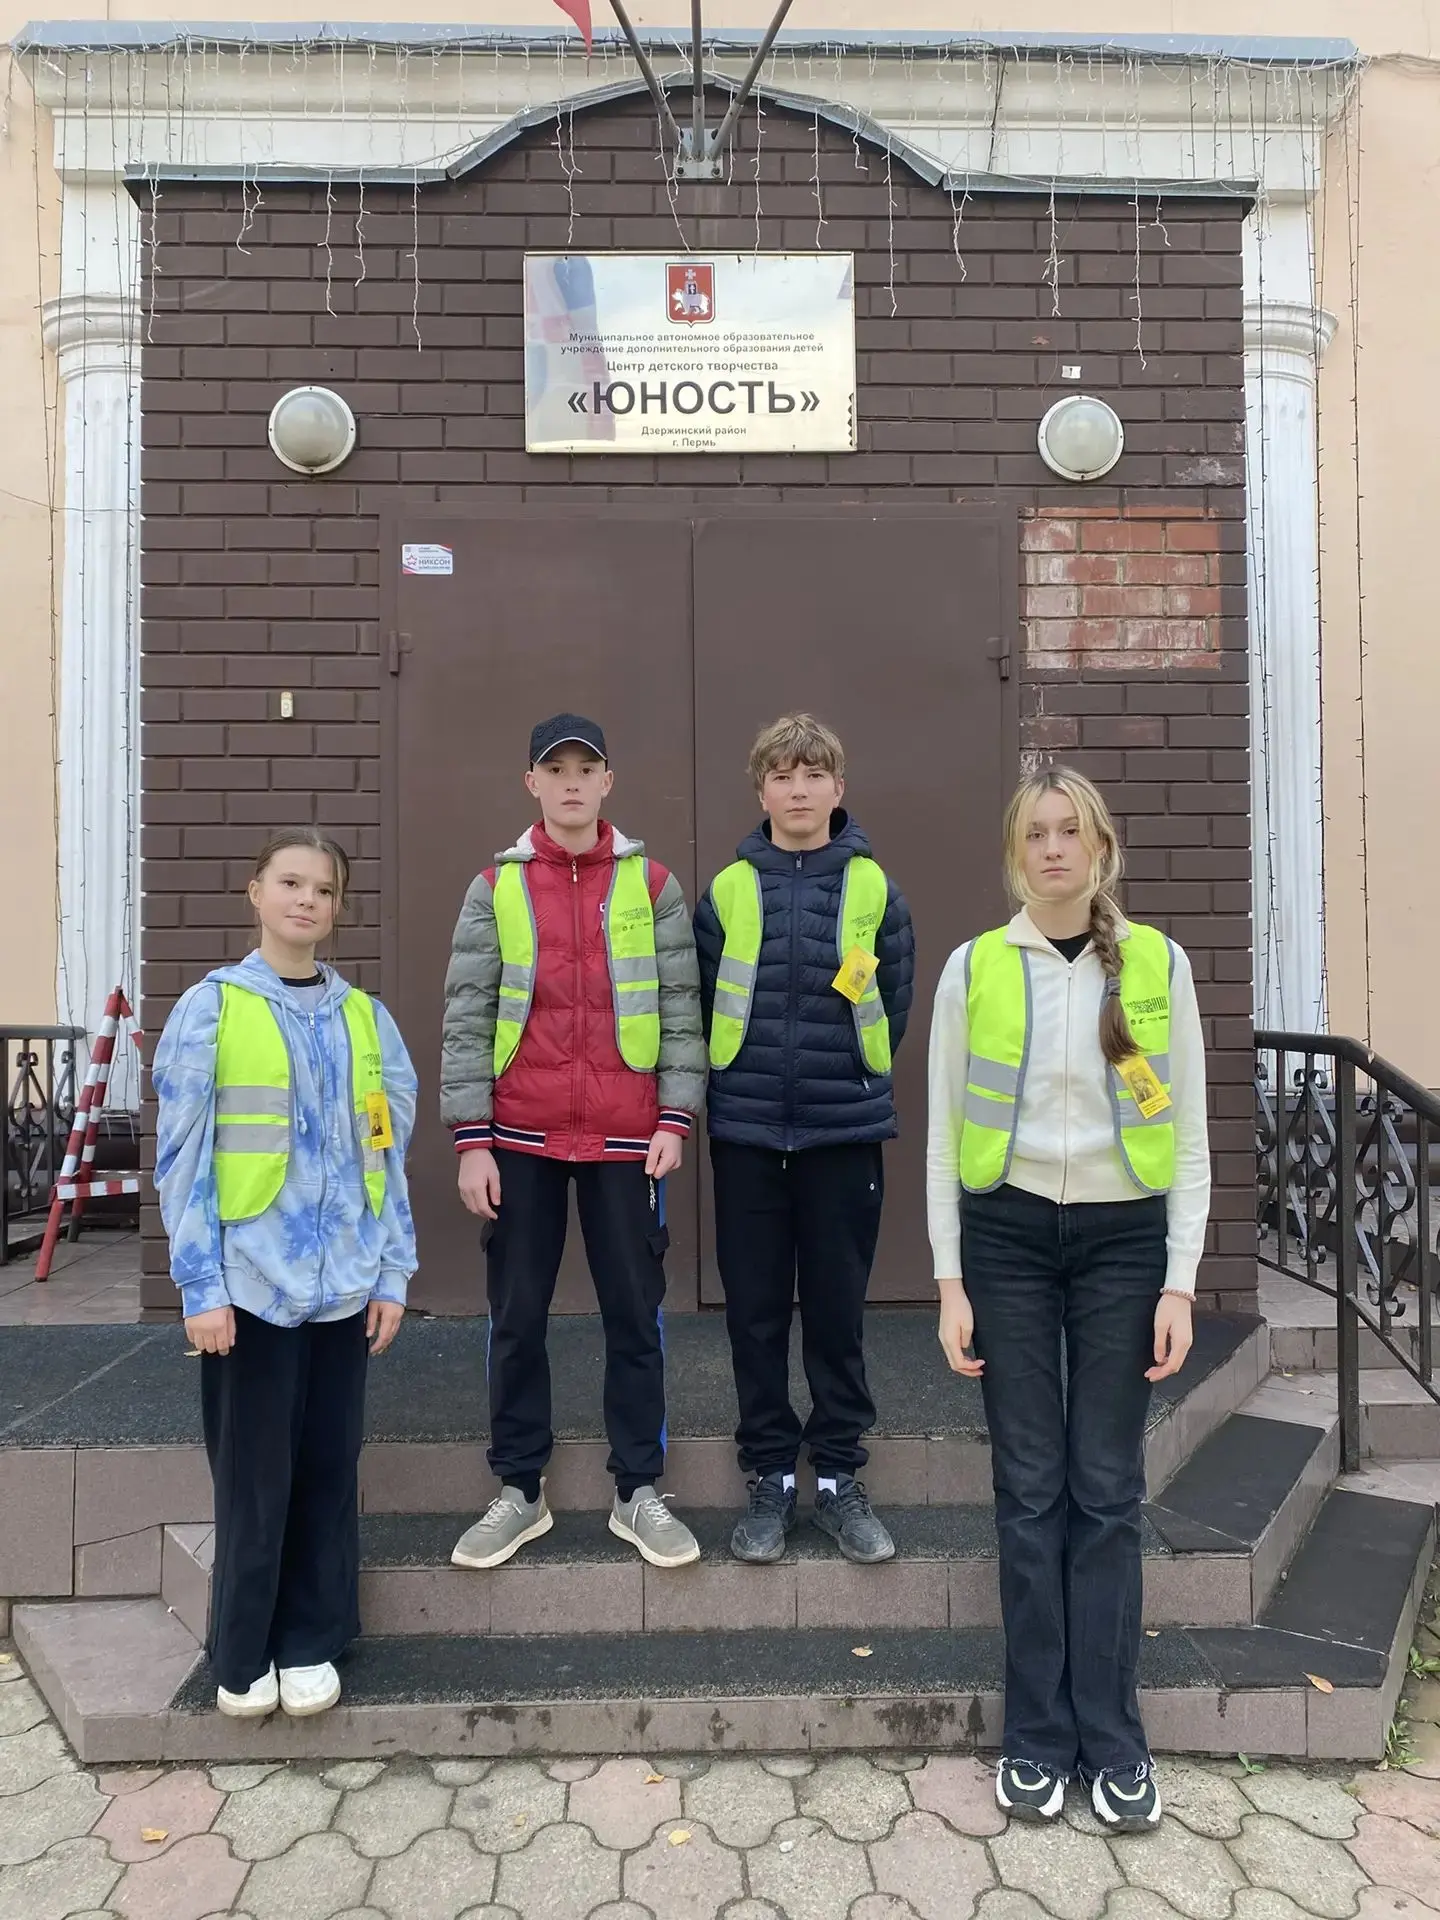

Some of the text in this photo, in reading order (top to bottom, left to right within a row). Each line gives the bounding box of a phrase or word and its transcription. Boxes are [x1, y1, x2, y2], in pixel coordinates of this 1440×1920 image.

[569, 332, 815, 342] Муниципальное автономное образовательное
[560, 342, 824, 354] учреждение дополнительного образования детей
[607, 361, 778, 373] Центр детского творчества
[567, 381, 820, 414] «ЮНОСТЬ»
[641, 425, 747, 437] Дзержинский район
[682, 438, 717, 448] Пермь
